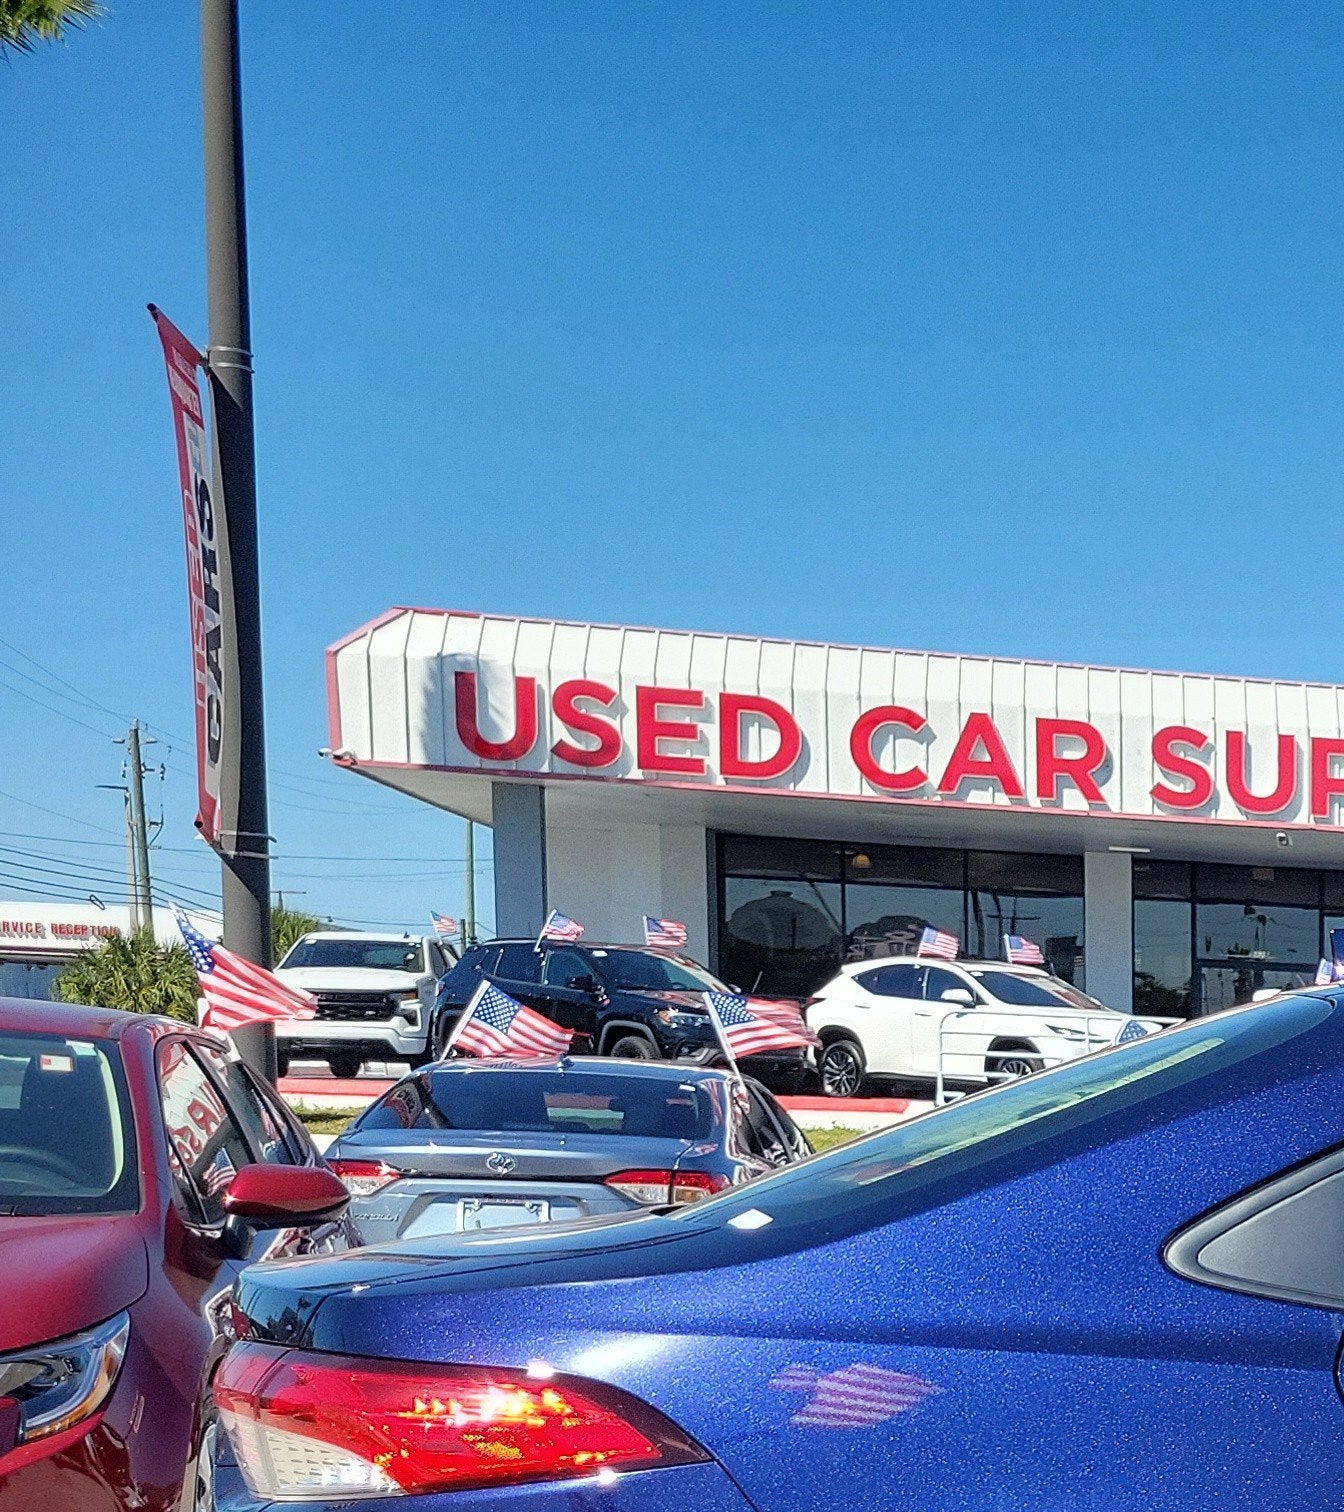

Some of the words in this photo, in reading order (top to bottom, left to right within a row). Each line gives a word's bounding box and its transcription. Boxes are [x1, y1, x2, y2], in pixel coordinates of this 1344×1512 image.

[195, 478, 223, 764] CARS
[459, 677, 801, 778] USED
[850, 706, 1104, 801] CAR
[0, 920, 42, 934] RVICE
